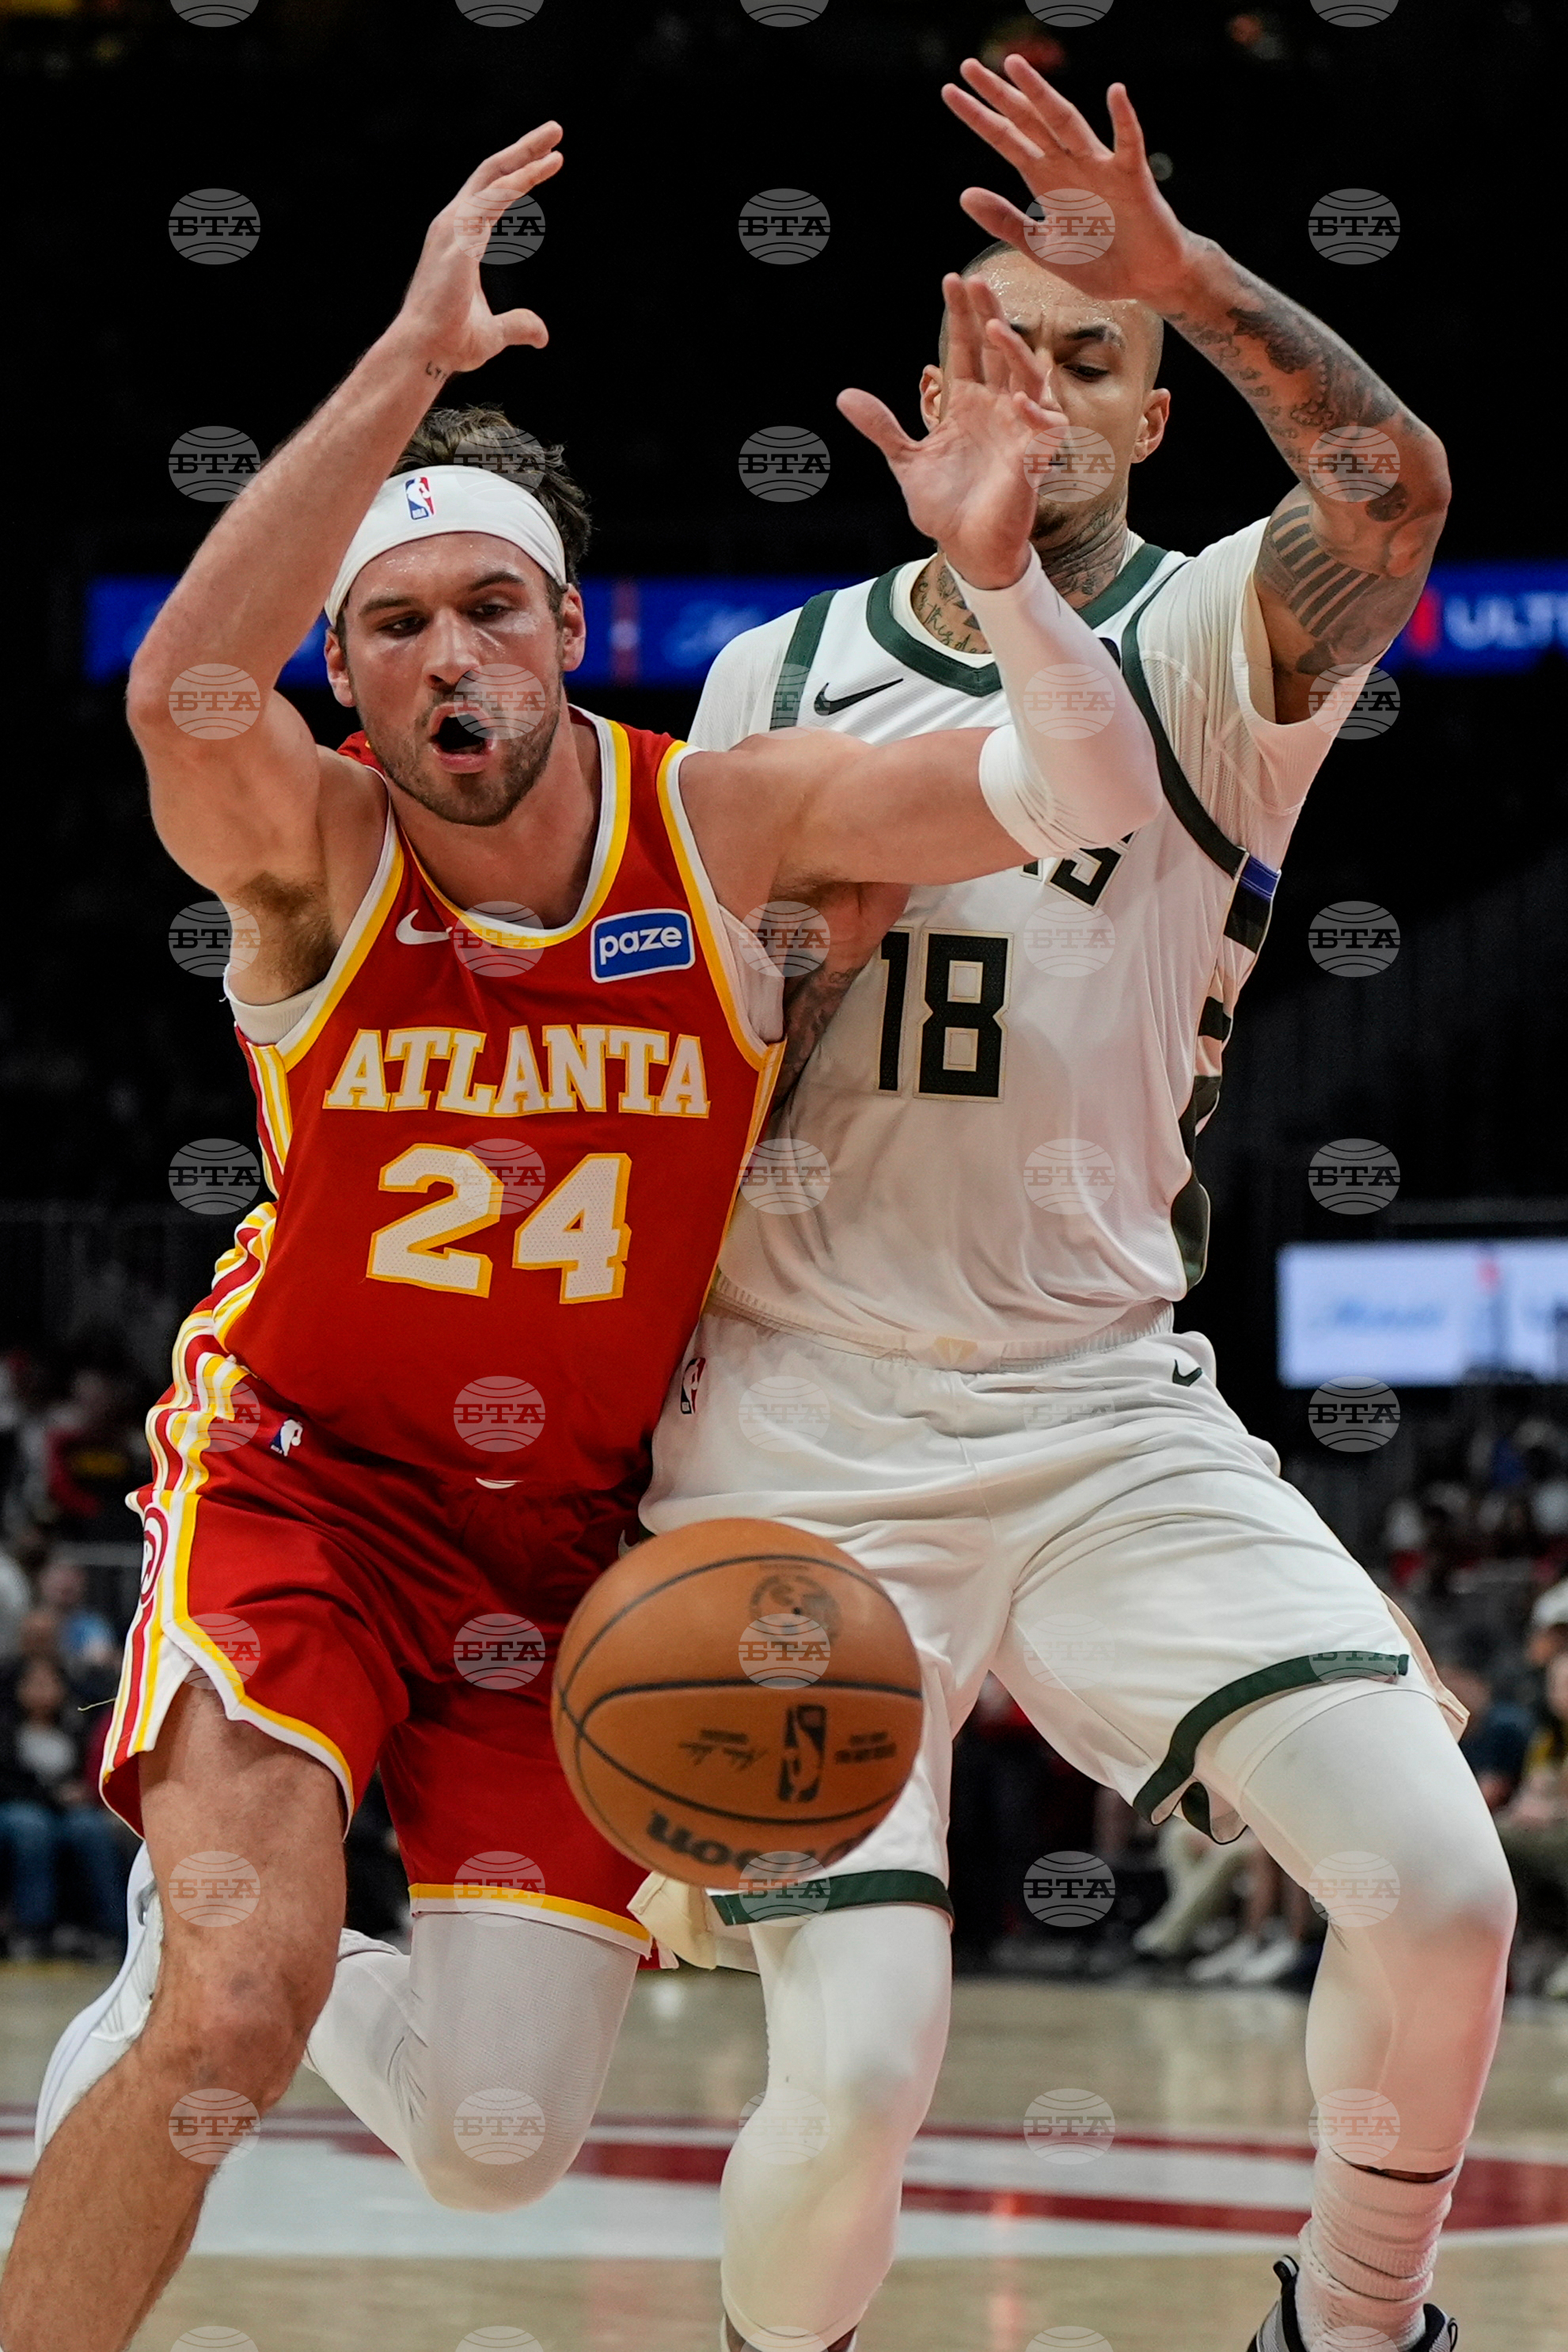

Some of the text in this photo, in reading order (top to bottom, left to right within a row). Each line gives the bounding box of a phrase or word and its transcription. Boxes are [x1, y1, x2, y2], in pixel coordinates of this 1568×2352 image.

[599, 926, 682, 965] paze
[322, 1024, 711, 1118] ATLANTA
[876, 928, 1013, 1101] 18
[366, 1143, 632, 1304] 24
